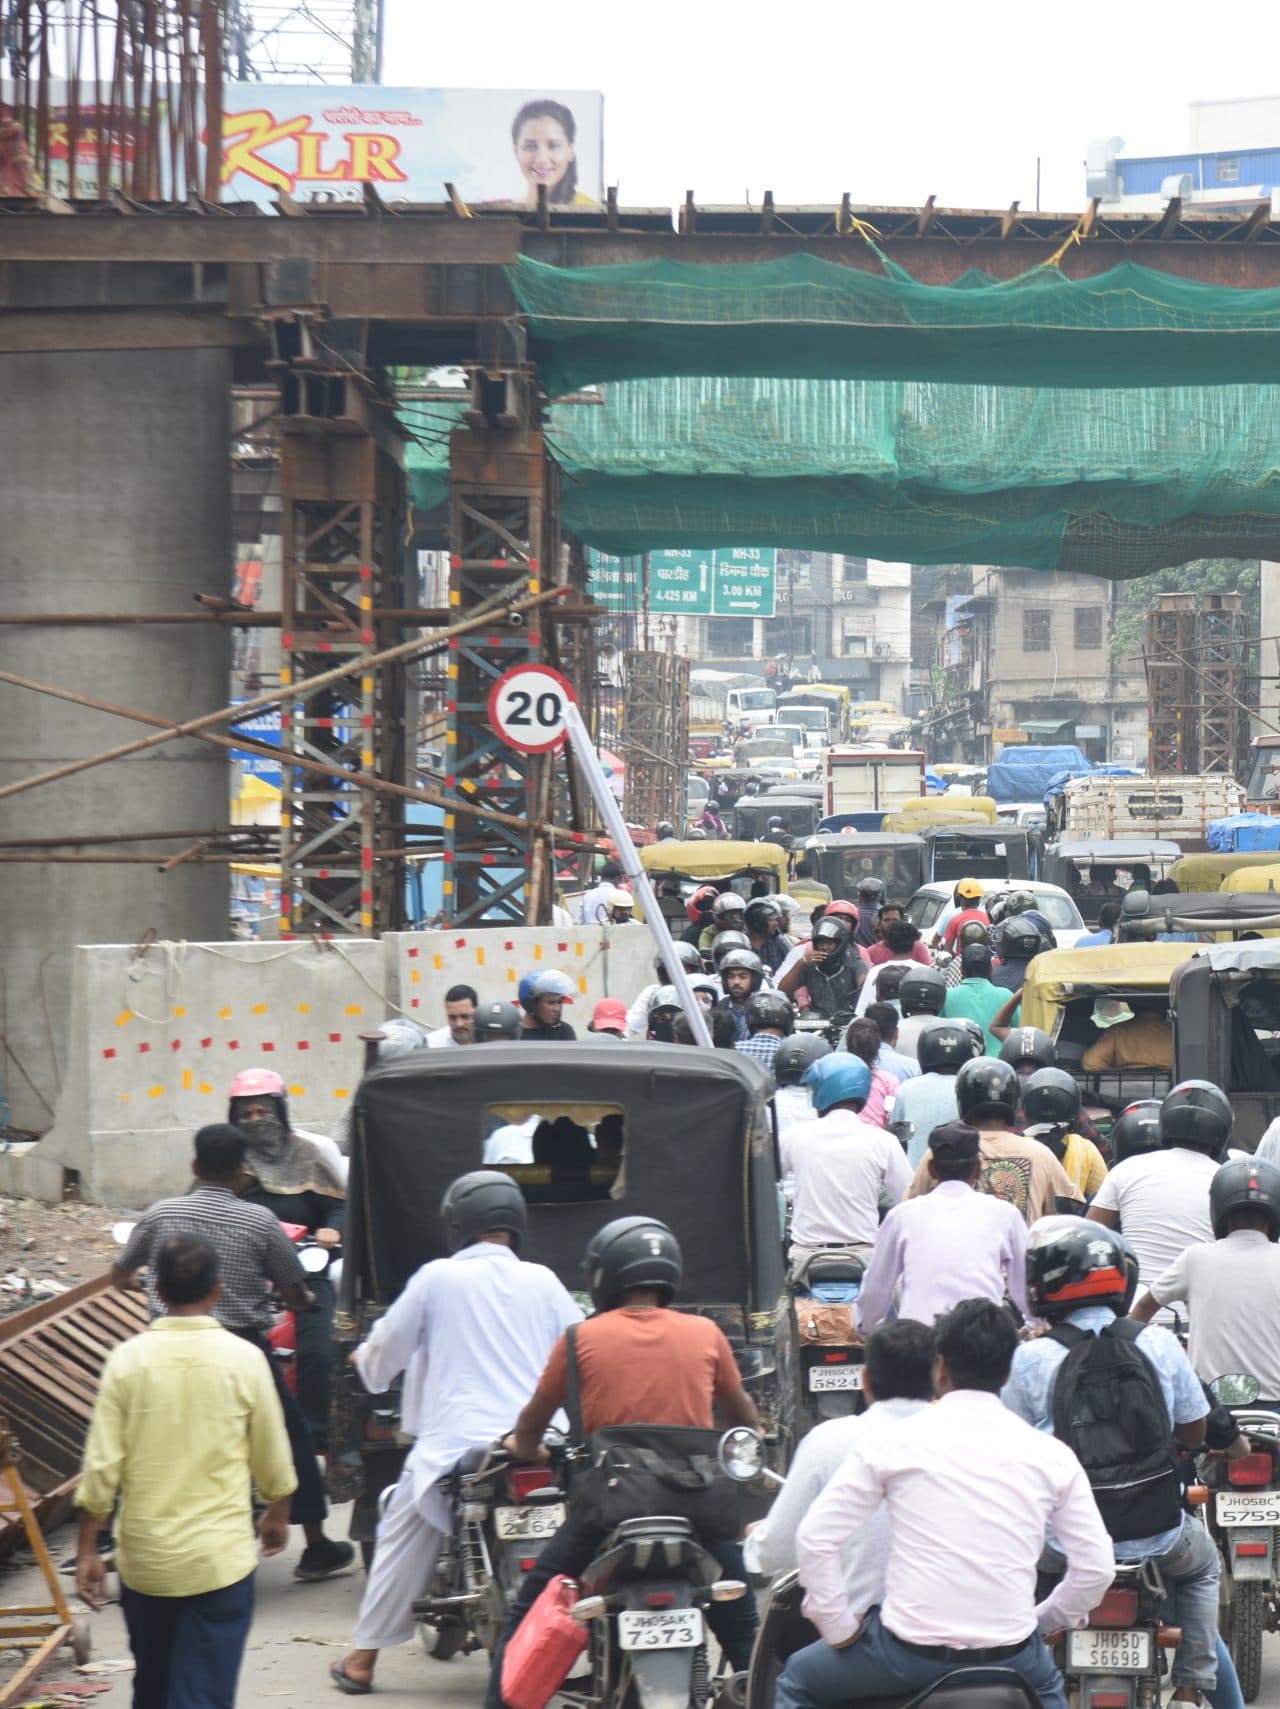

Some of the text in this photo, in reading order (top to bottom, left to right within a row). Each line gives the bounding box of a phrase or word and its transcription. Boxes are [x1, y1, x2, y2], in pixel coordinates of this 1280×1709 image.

[203, 109, 409, 195] KLR
[655, 590, 698, 603] 4.425 KM
[722, 584, 762, 597] 3.00 KM
[505, 691, 562, 727] 20
[814, 1377, 859, 1389] 5824
[1226, 1498, 1275, 1506] JH05BC
[1223, 1510, 1280, 1522] 5759
[1091, 1632, 1140, 1649] JH05D
[1090, 1650, 1140, 1666] S6698
